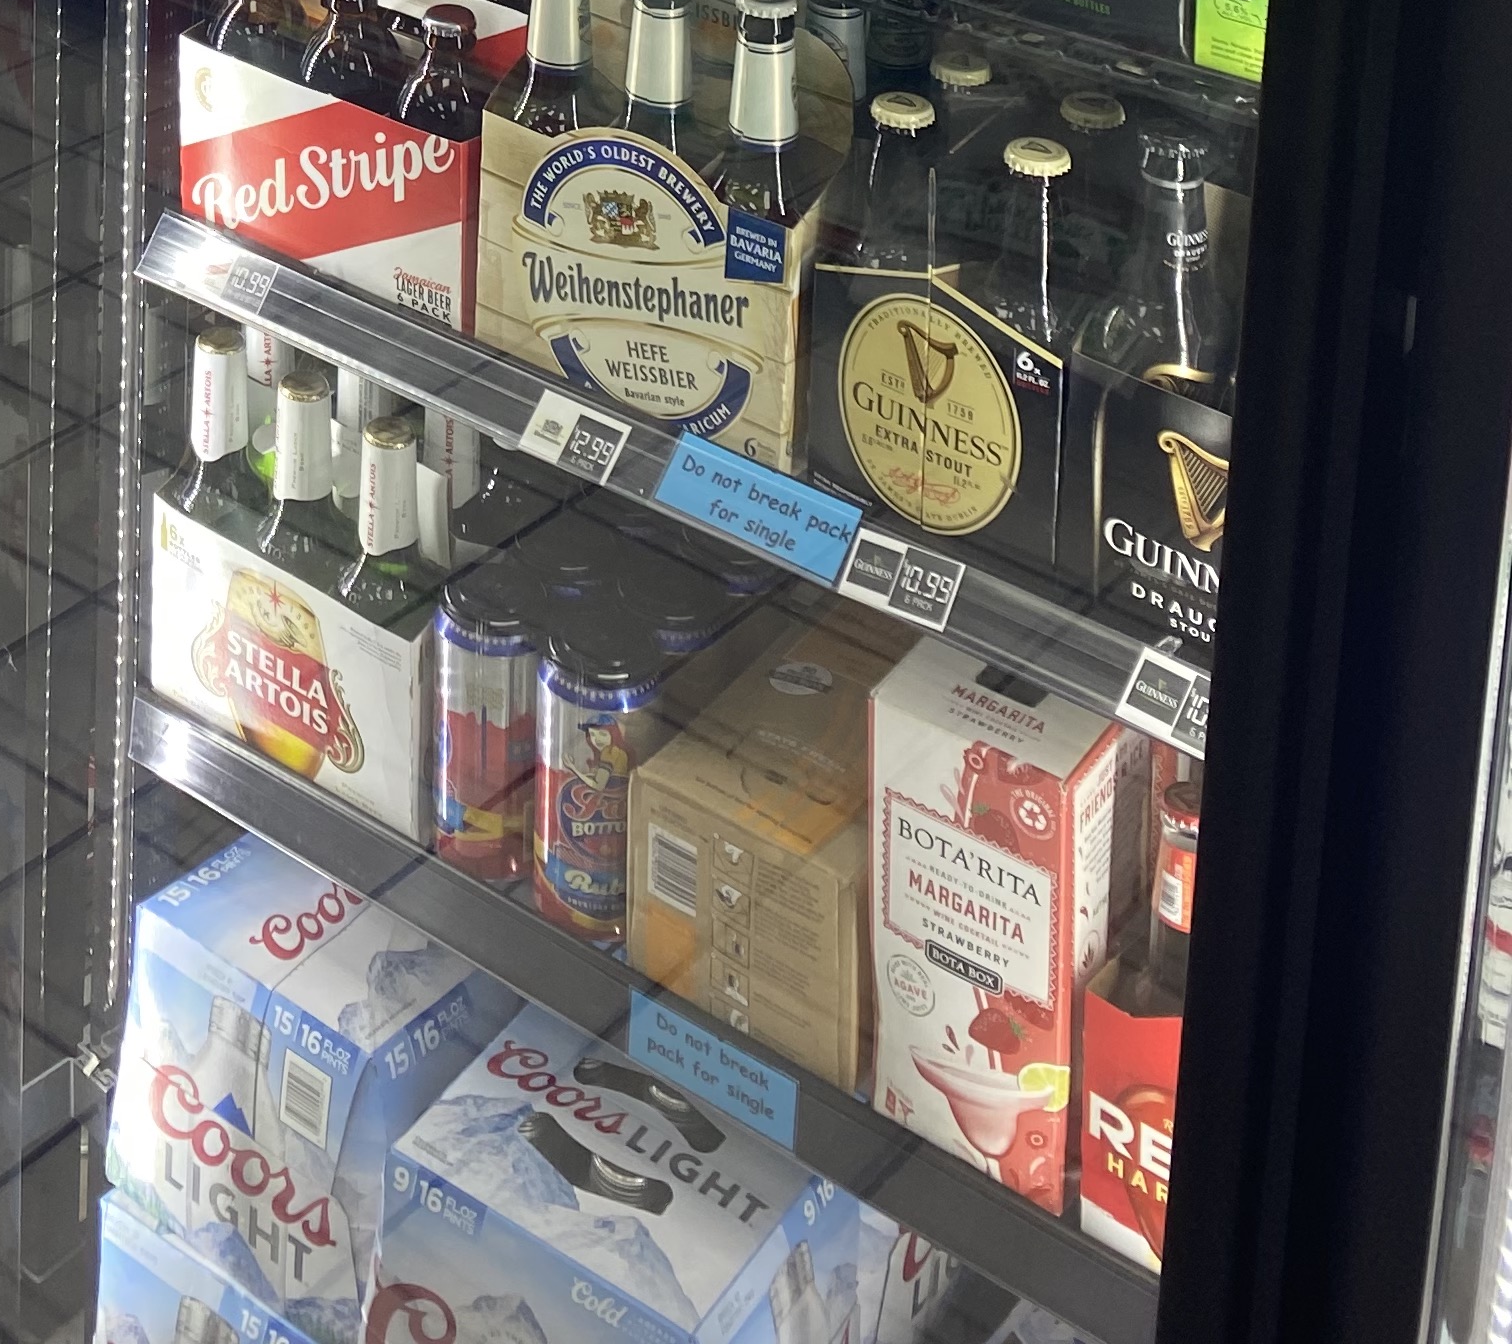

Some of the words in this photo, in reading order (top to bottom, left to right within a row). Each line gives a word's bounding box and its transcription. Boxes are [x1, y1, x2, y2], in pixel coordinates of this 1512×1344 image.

[191, 157, 295, 230] Red
[296, 131, 455, 211] Stripe
[530, 183, 551, 211] THE
[543, 144, 597, 183] WORLD'S
[600, 144, 656, 173] OLDEST
[658, 167, 717, 233] BREWERY
[729, 234, 783, 264] BAVARIA
[734, 249, 778, 274] GERMANY
[735, 225, 768, 246] BREWED
[768, 236, 778, 249] IN
[393, 266, 453, 295] Jamaican
[395, 276, 425, 303] LAGER
[427, 288, 452, 312] BEER
[522, 252, 749, 329] Weihenstephaner
[397, 293, 405, 304] 6
[410, 299, 452, 325] PACK
[605, 357, 700, 392] WEISSBIER
[625, 340, 670, 363] HEFE
[624, 386, 661, 404] Bavarian
[664, 395, 686, 408] style
[852, 380, 1002, 468] GUINNESS
[875, 424, 920, 454] EXTRA
[925, 449, 974, 479] STOUT
[682, 455, 706, 480] Do
[710, 469, 742, 497] not
[747, 481, 804, 520] break
[807, 509, 853, 546] pack
[707, 497, 740, 523] for
[743, 515, 797, 555] single
[853, 558, 894, 581] GUINNESS
[226, 631, 329, 710] STELLA
[1135, 678, 1180, 710] GUINNESS
[223, 661, 330, 736] ARTOIS
[951, 683, 1046, 735] MARGARITA
[157, 882, 190, 909] 15
[188, 864, 220, 890] 16
[898, 816, 1042, 907] BOTA'RITA
[908, 868, 1026, 947] MARGARITA
[921, 917, 1010, 969] STRAWBERRY
[928, 948, 966, 976] BOTA
[968, 964, 996, 989] BOX
[893, 977, 929, 1002] AGAVE
[273, 1004, 295, 1035] 15
[299, 1021, 323, 1055] 16
[386, 1046, 413, 1081] 15
[411, 1019, 441, 1052] 16
[655, 1013, 680, 1037] Do
[684, 1030, 713, 1056] not
[719, 1048, 772, 1092] break
[320, 1050, 351, 1077] PINTS
[646, 1036, 686, 1070] pack
[691, 1059, 721, 1087] for
[726, 1081, 776, 1122] single
[148, 1063, 337, 1248] Coors
[486, 1039, 630, 1136] Coors
[625, 1123, 773, 1225] LIGHT
[165, 1141, 313, 1283] LIGHT
[392, 1164, 410, 1192] 9
[419, 1180, 444, 1213] 16
[803, 1197, 817, 1227] 9
[816, 1176, 837, 1206] 16
[442, 1207, 478, 1237] PINTS
